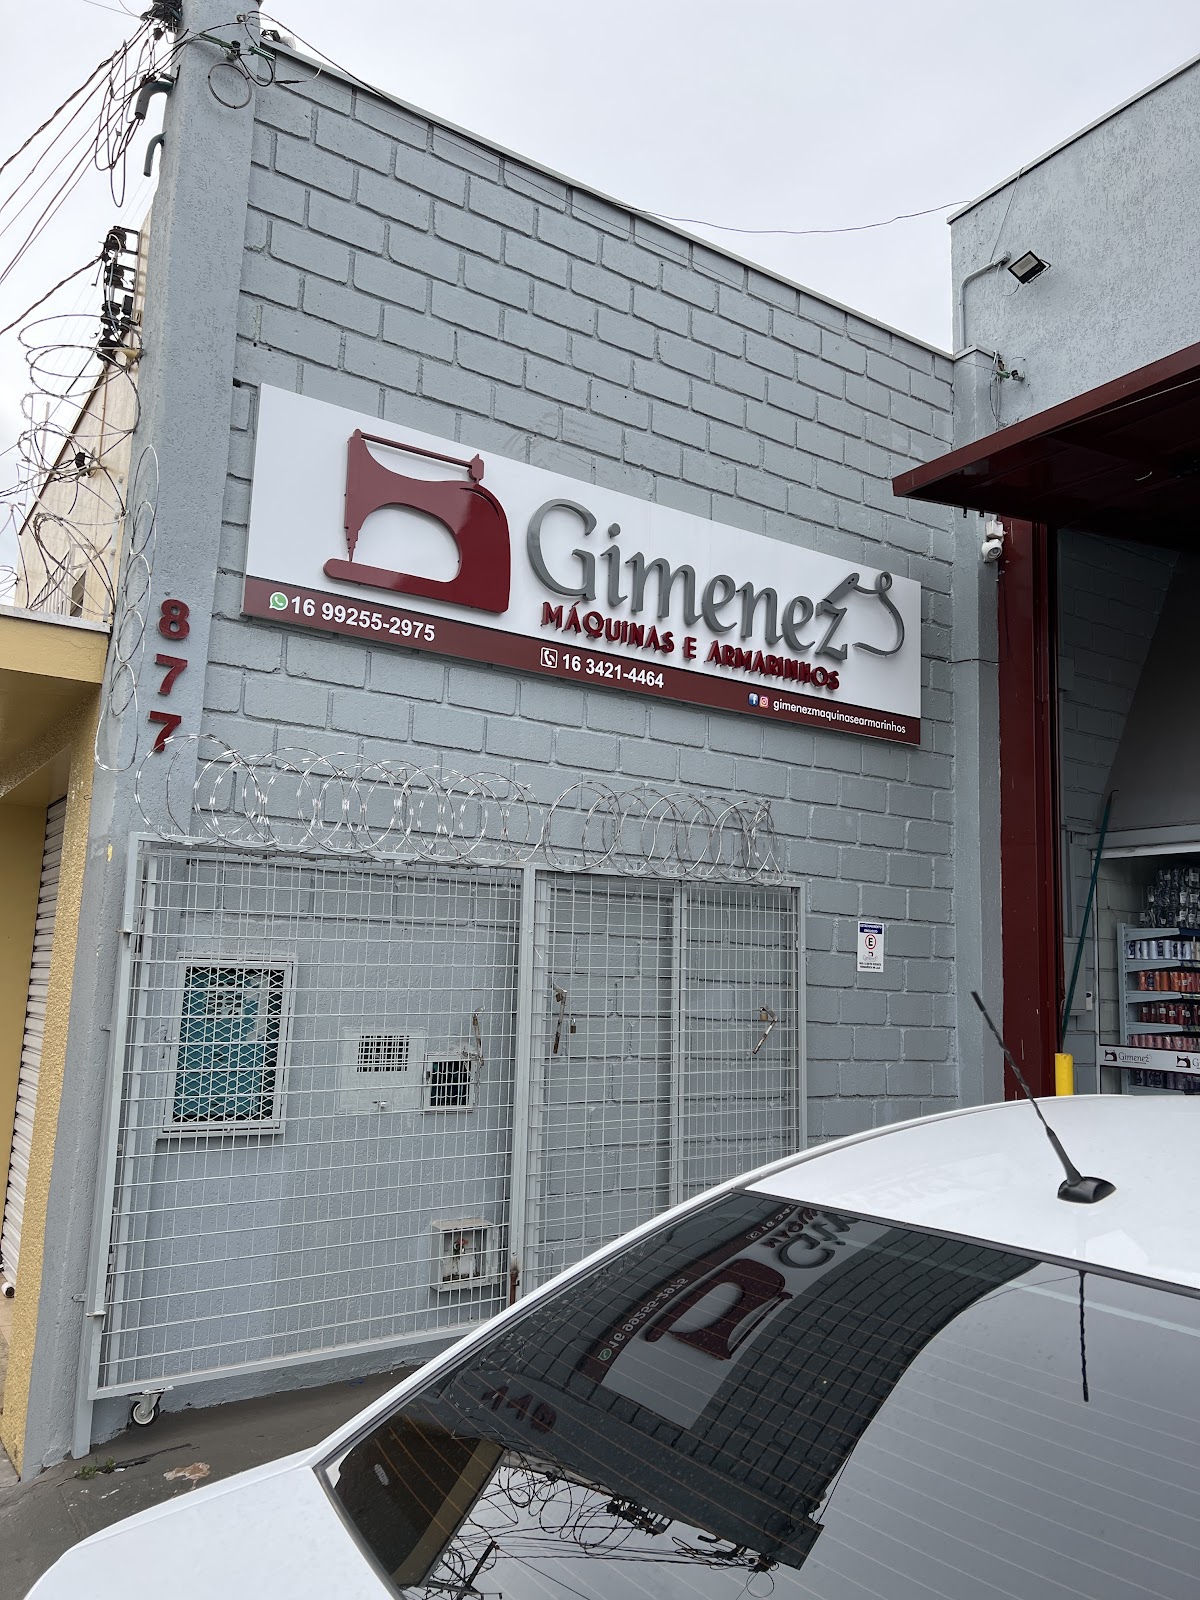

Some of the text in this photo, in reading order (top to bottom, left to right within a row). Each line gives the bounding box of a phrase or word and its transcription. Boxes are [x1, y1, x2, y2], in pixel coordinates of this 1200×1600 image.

[527, 498, 860, 660] Gimenez
[291, 596, 435, 642] 16 99255-2975
[540, 601, 840, 691] MÁQUINAS E ARMARINHOS
[148, 598, 190, 753] 877
[562, 653, 665, 689] 16 3421-4464
[773, 698, 907, 734] gimenezmaquinasearmarinhos
[868, 937, 874, 947] E
